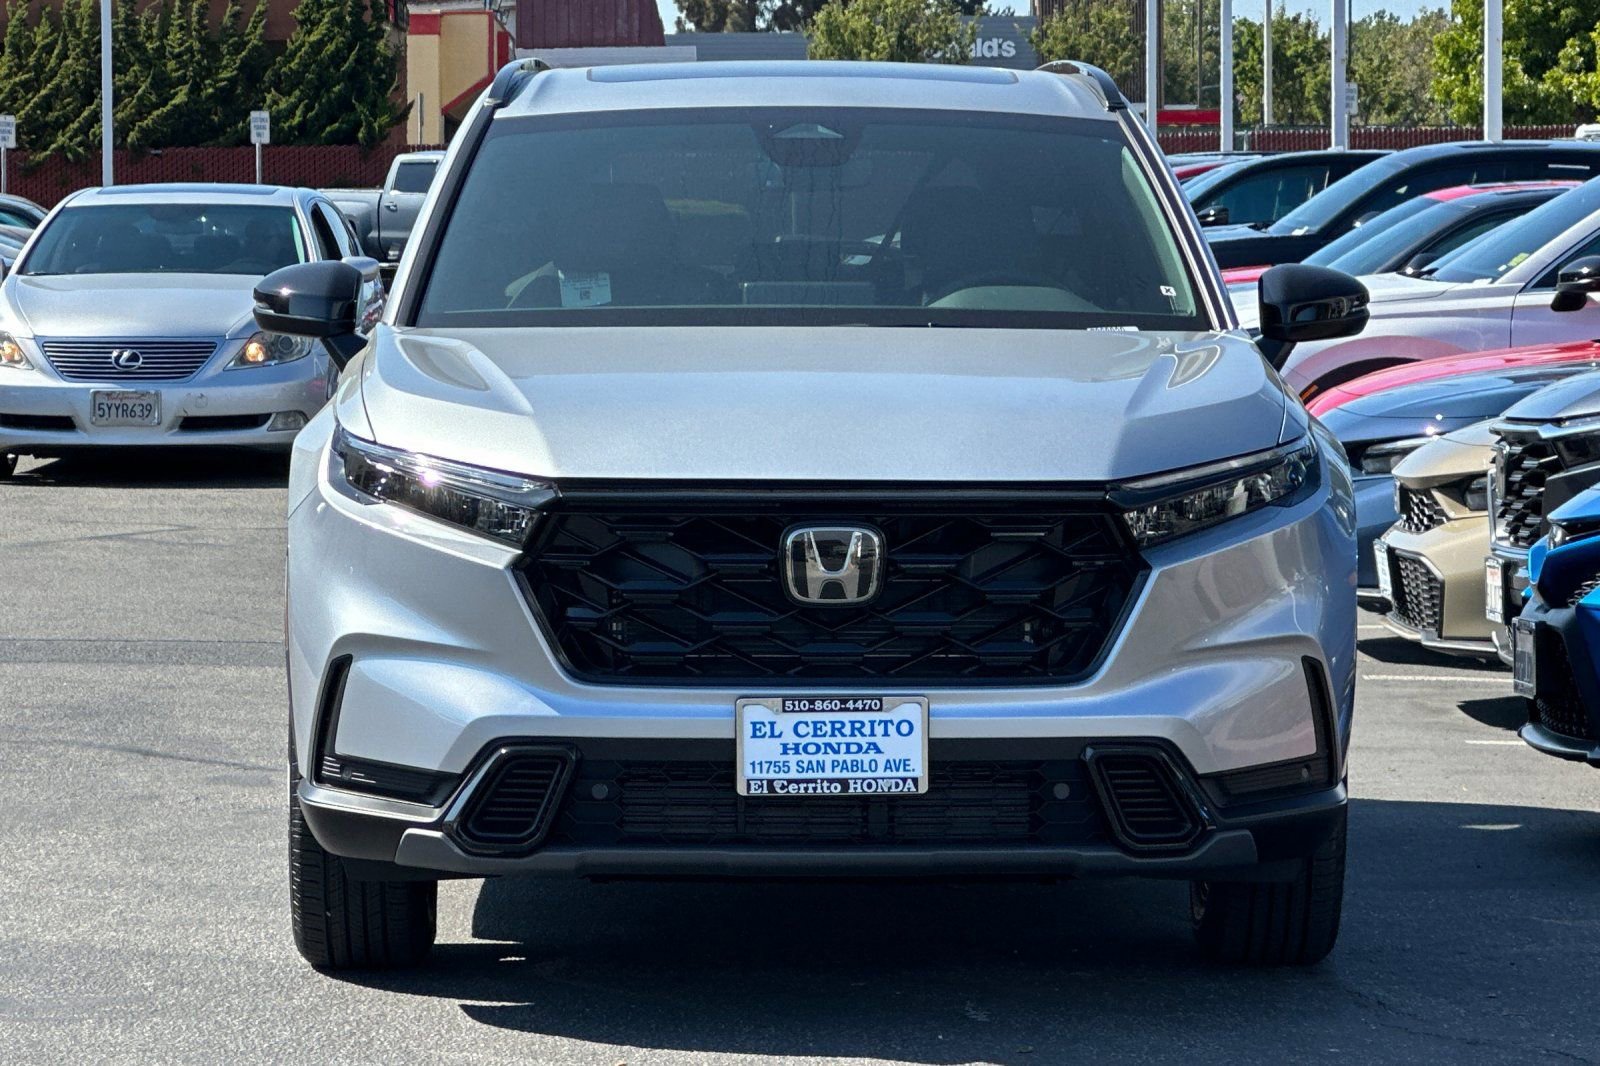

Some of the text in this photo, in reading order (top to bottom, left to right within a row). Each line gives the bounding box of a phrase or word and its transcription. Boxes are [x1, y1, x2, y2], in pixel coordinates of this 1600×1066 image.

[97, 402, 153, 418] 5YYR639
[784, 699, 881, 711] 510-860-4470
[750, 719, 915, 739] EL CERRITO
[779, 741, 885, 756] HONDA
[750, 758, 916, 774] 11755 SAN PABLO AVE.
[749, 778, 917, 794] El Cerrito HONDA
